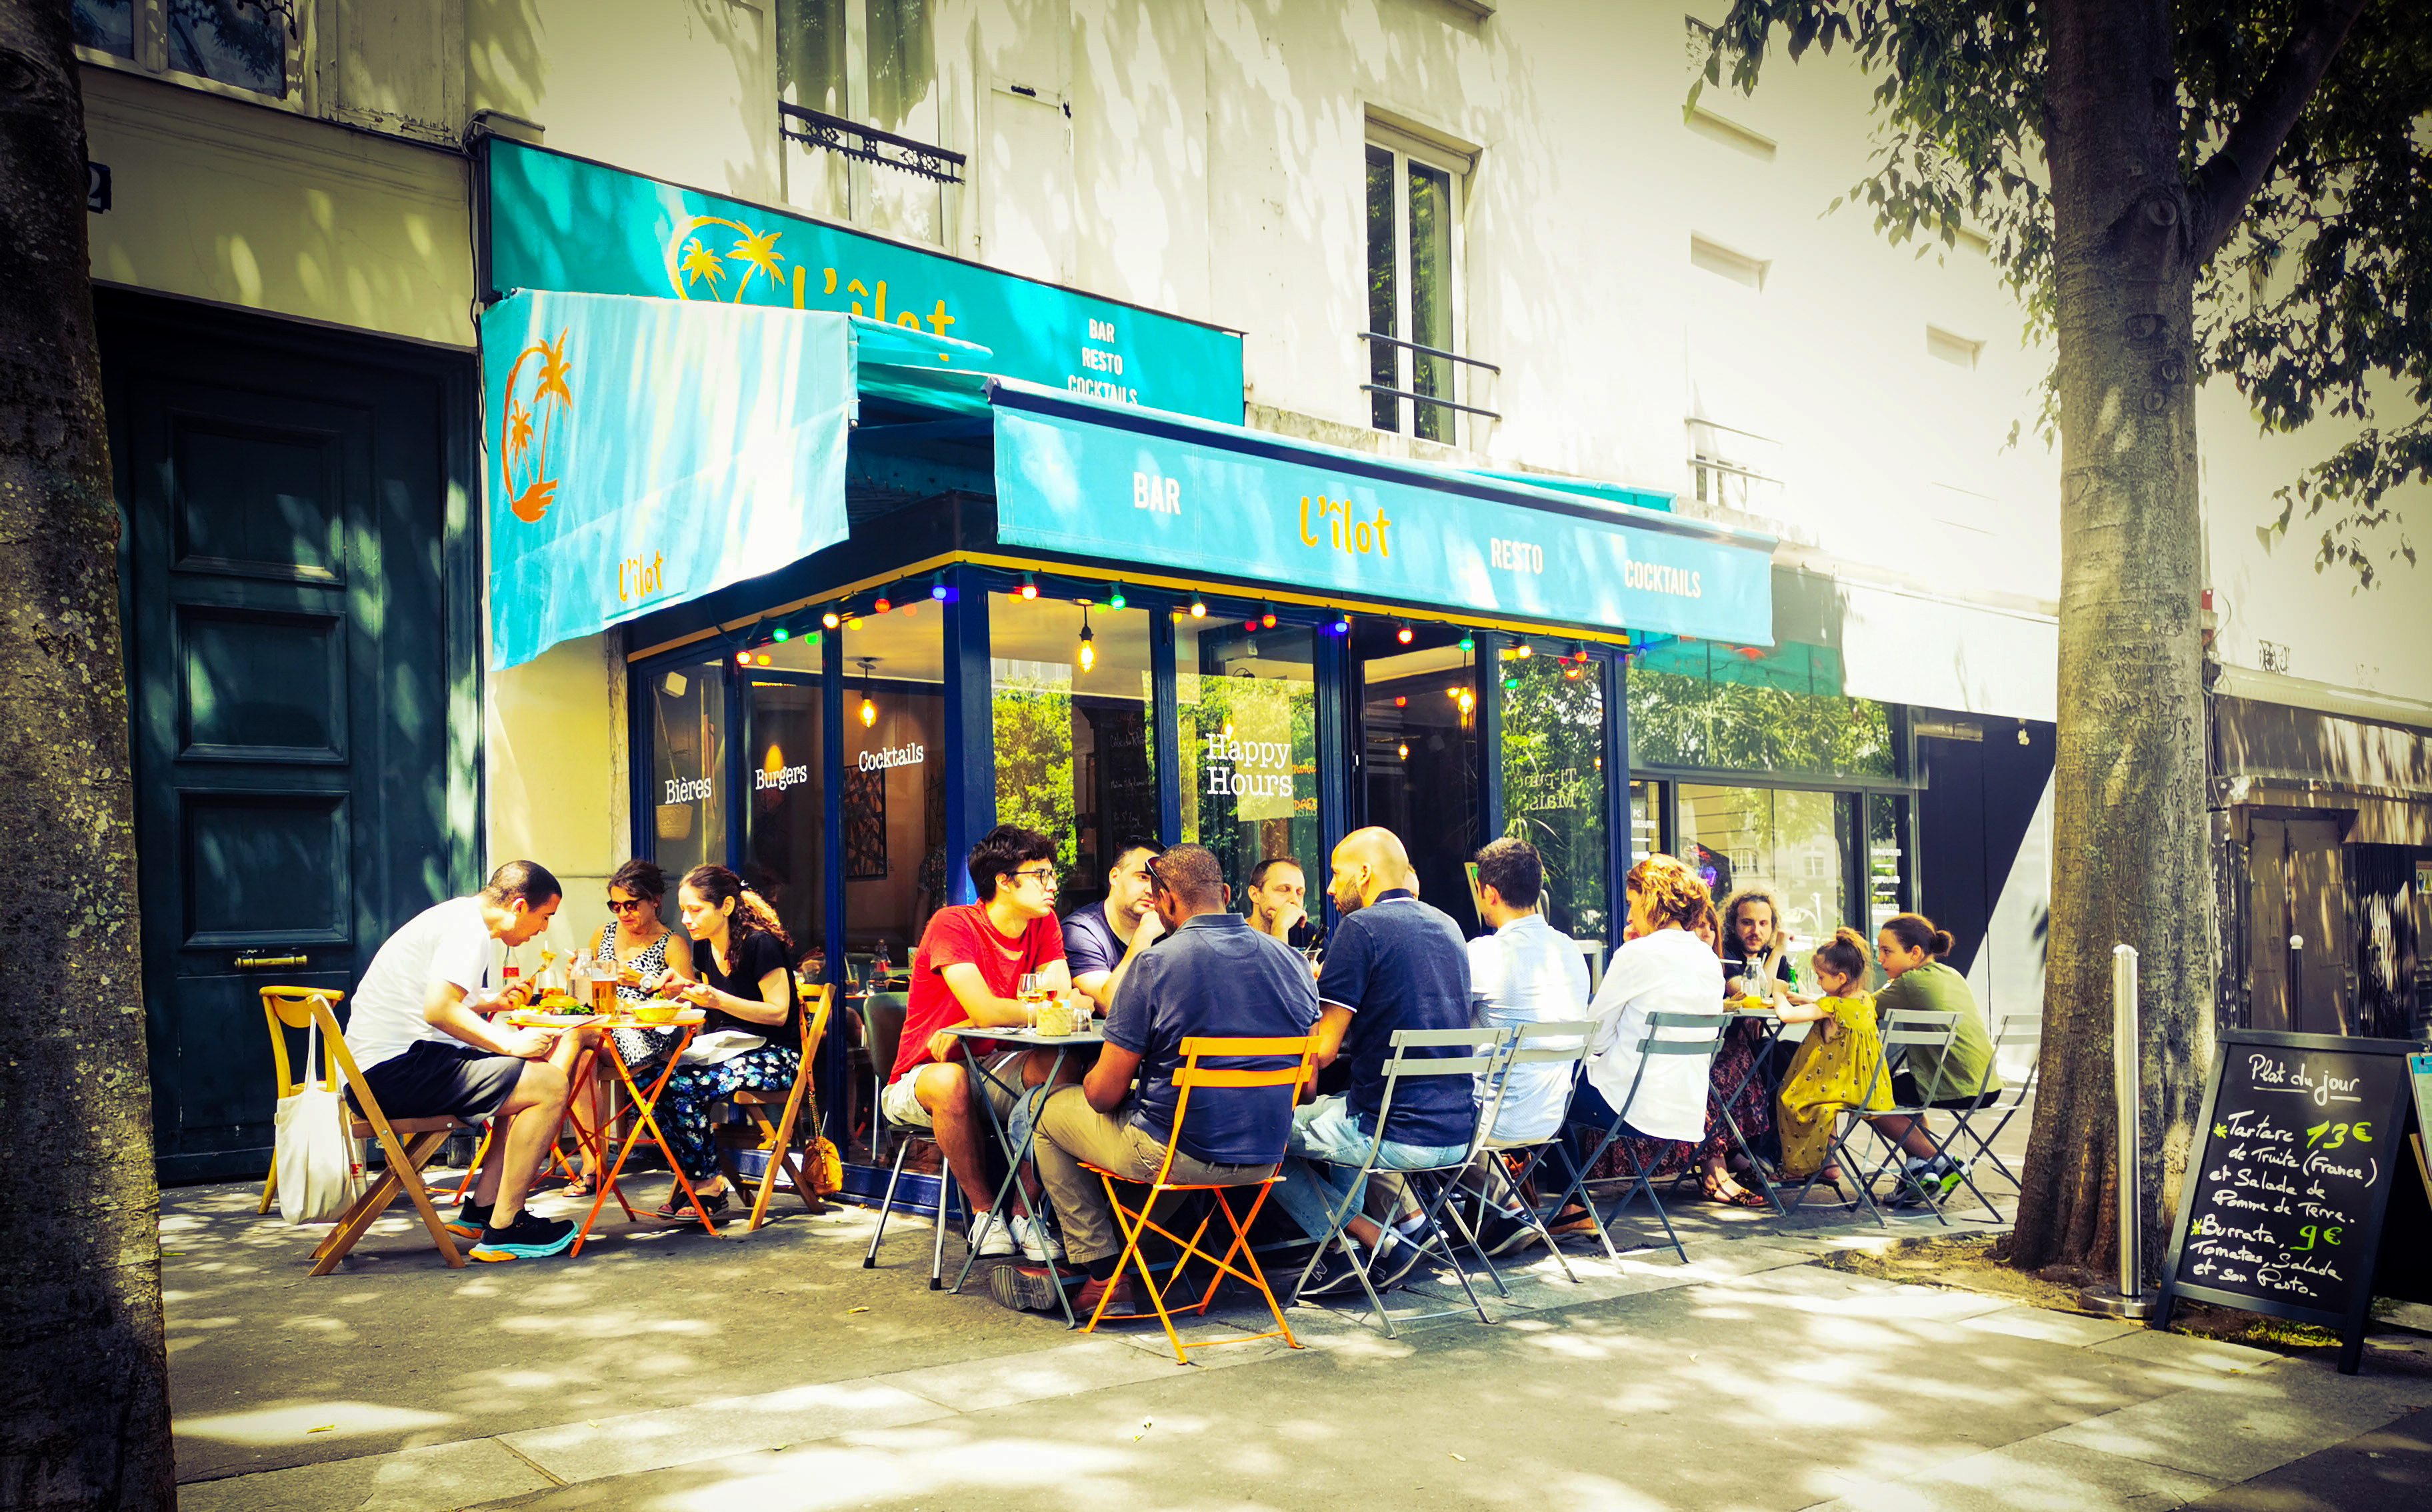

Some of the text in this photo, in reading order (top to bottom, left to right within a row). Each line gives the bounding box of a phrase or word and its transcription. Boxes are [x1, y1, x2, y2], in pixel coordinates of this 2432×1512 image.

[1089, 318, 1115, 343] BAR
[1081, 346, 1123, 376] RESTO
[1067, 374, 1139, 405] COCKTAILS
[1133, 471, 1701, 599] BAR L'îlot RESTO COCKTAILS
[859, 741, 925, 773] Cocktails
[1205, 733, 1291, 770] Happy
[665, 777, 712, 805] Bières
[755, 765, 807, 791] Burgers
[1206, 766, 1293, 797] Hours
[1632, 809, 1642, 818] PC
[2249, 1053, 2361, 1107] Plat du jour
[2228, 1109, 2373, 1149] Tartare 13€
[2228, 1142, 2247, 1161] de
[2251, 1146, 2300, 1168] Truite
[2209, 1164, 2326, 1200] et Salade de
[2211, 1189, 2269, 1212] Pomme
[2273, 1197, 2292, 1215] de
[2193, 1257, 2217, 1275] et
[2218, 1268, 2247, 1282] son
[2271, 1252, 2343, 1281] Salade
